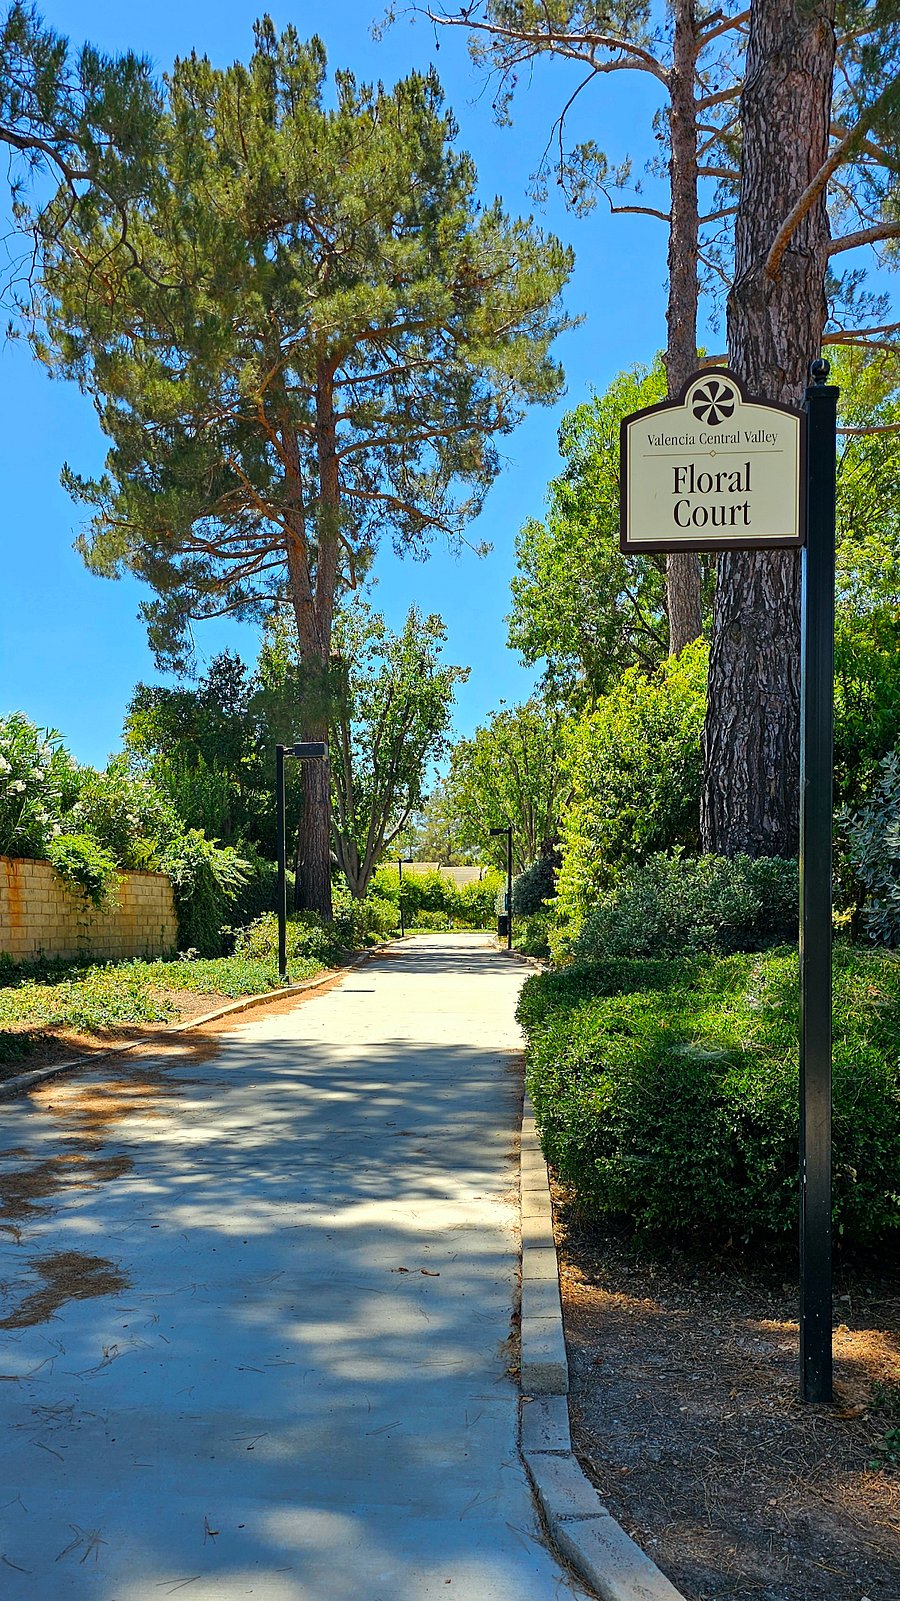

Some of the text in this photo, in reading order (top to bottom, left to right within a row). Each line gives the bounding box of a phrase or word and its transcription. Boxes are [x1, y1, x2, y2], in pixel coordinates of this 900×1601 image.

[647, 430, 778, 446] Valencia Central Valley
[672, 462, 752, 495] Floral
[673, 499, 752, 528] Court
